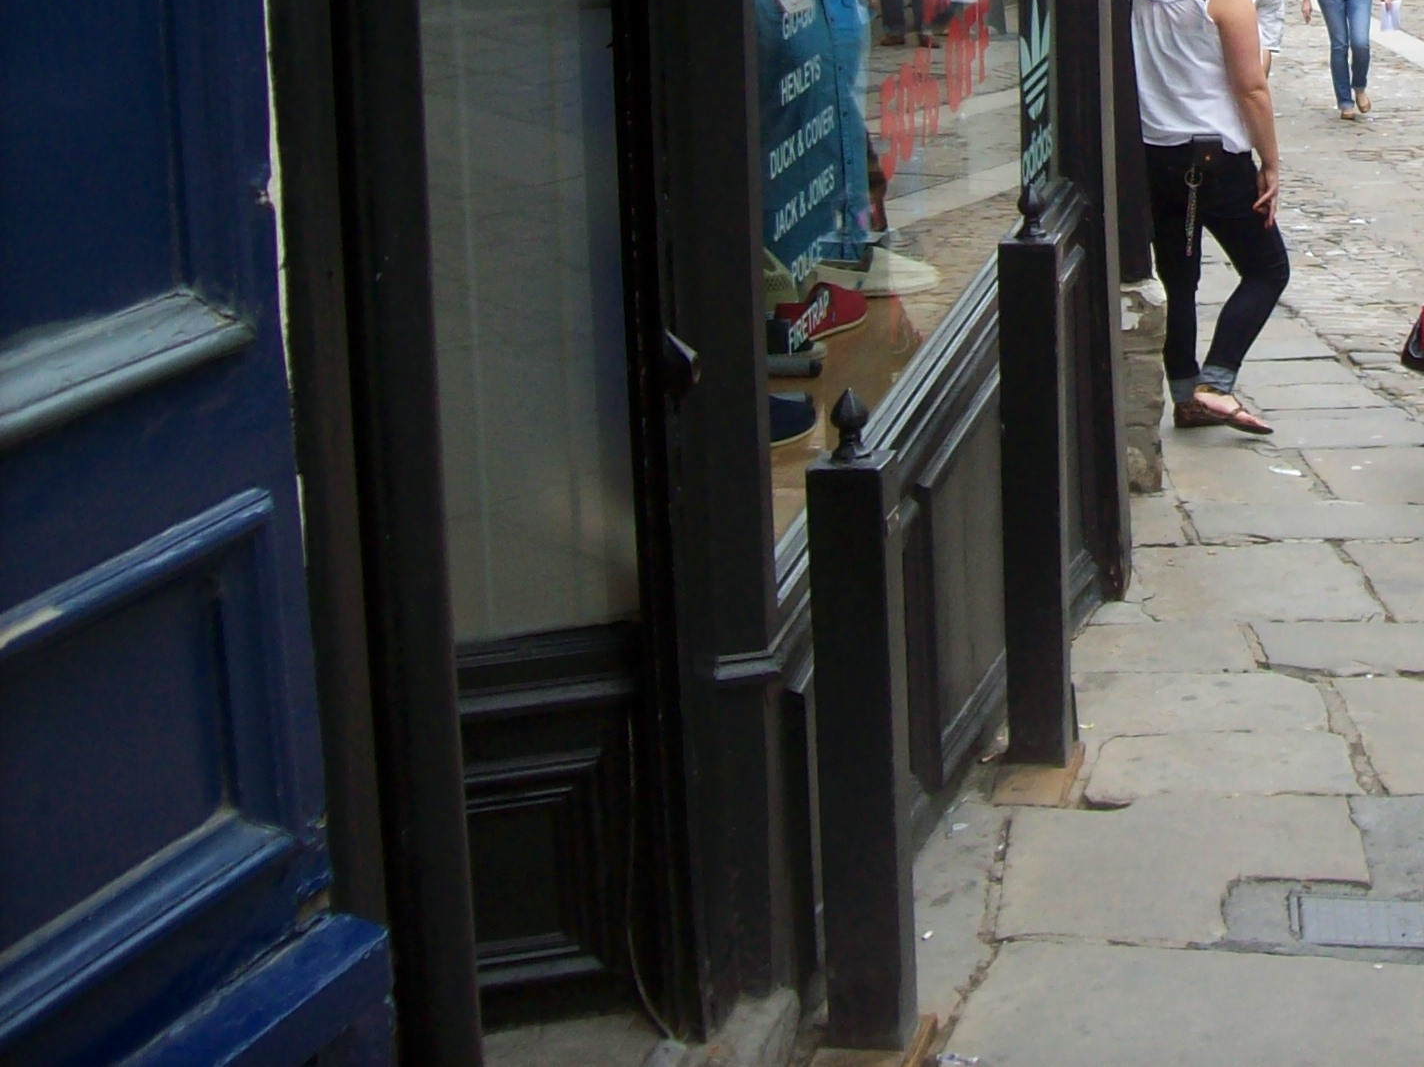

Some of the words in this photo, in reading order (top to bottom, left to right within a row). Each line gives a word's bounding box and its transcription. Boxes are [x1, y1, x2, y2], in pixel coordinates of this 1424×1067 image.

[780, 53, 822, 107] HENLEYS
[769, 134, 797, 180] DUCK
[797, 129, 805, 157] &
[805, 104, 835, 150] COVER
[773, 195, 798, 243] JACK
[799, 190, 807, 218] &
[807, 164, 836, 211] JONES
[791, 237, 823, 288] POLICE
[788, 288, 830, 357] FIRETRAP
